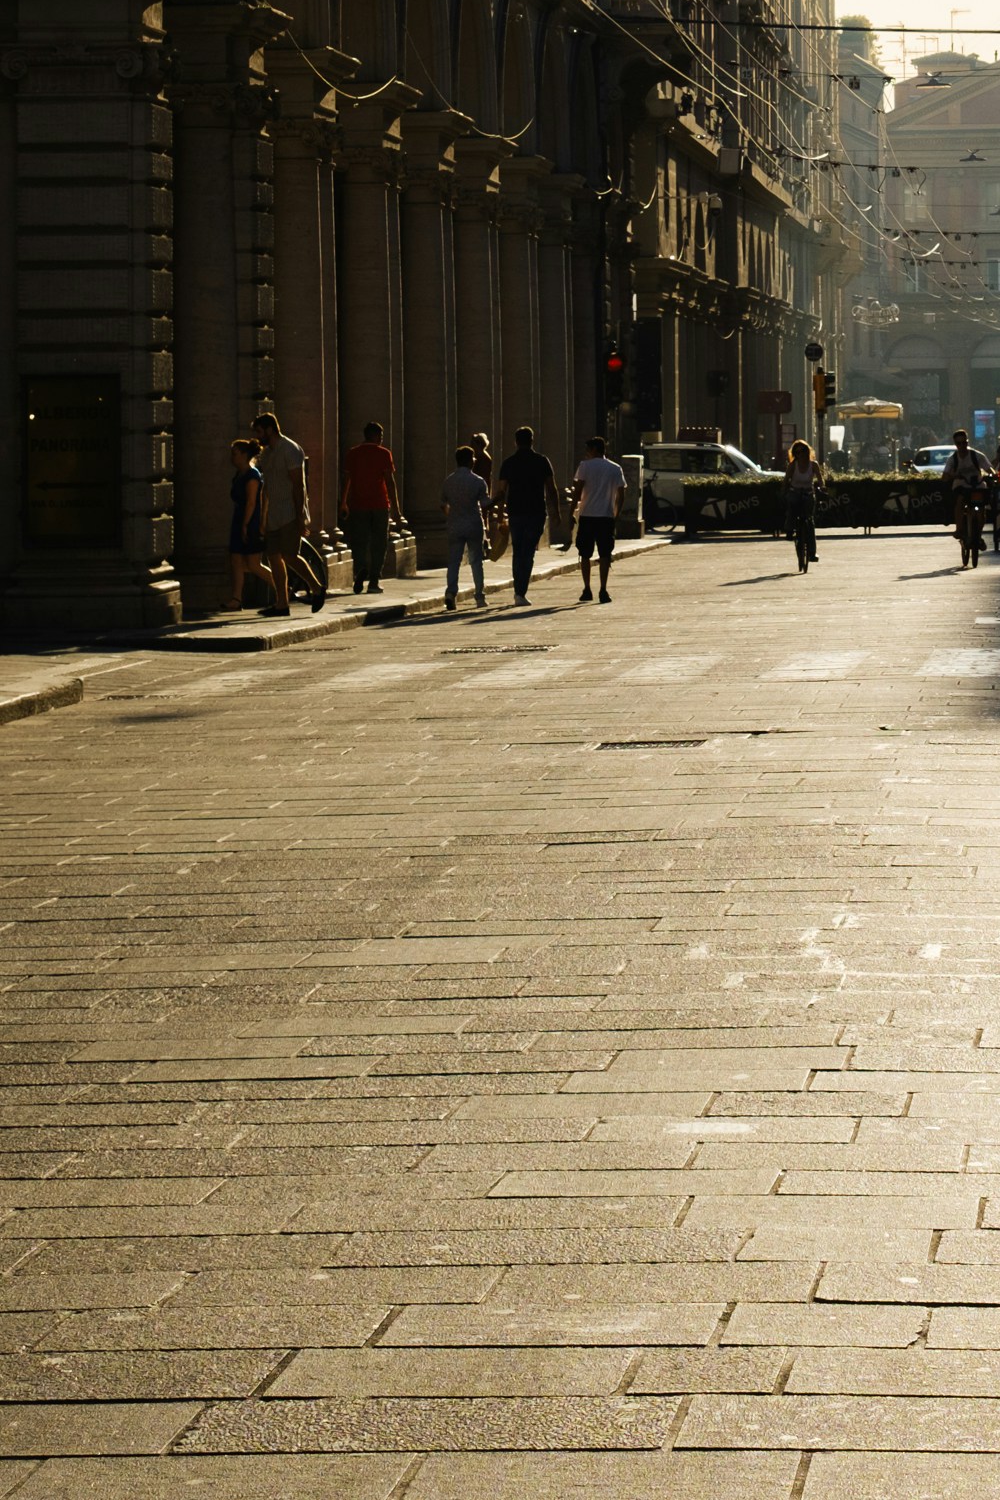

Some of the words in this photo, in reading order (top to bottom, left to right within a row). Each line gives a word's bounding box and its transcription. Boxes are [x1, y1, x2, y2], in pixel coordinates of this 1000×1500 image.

[32, 405, 111, 420] ALBERGO
[728, 495, 760, 515] DAYS
[819, 492, 851, 512] DAYS
[911, 491, 943, 509] DAYS
